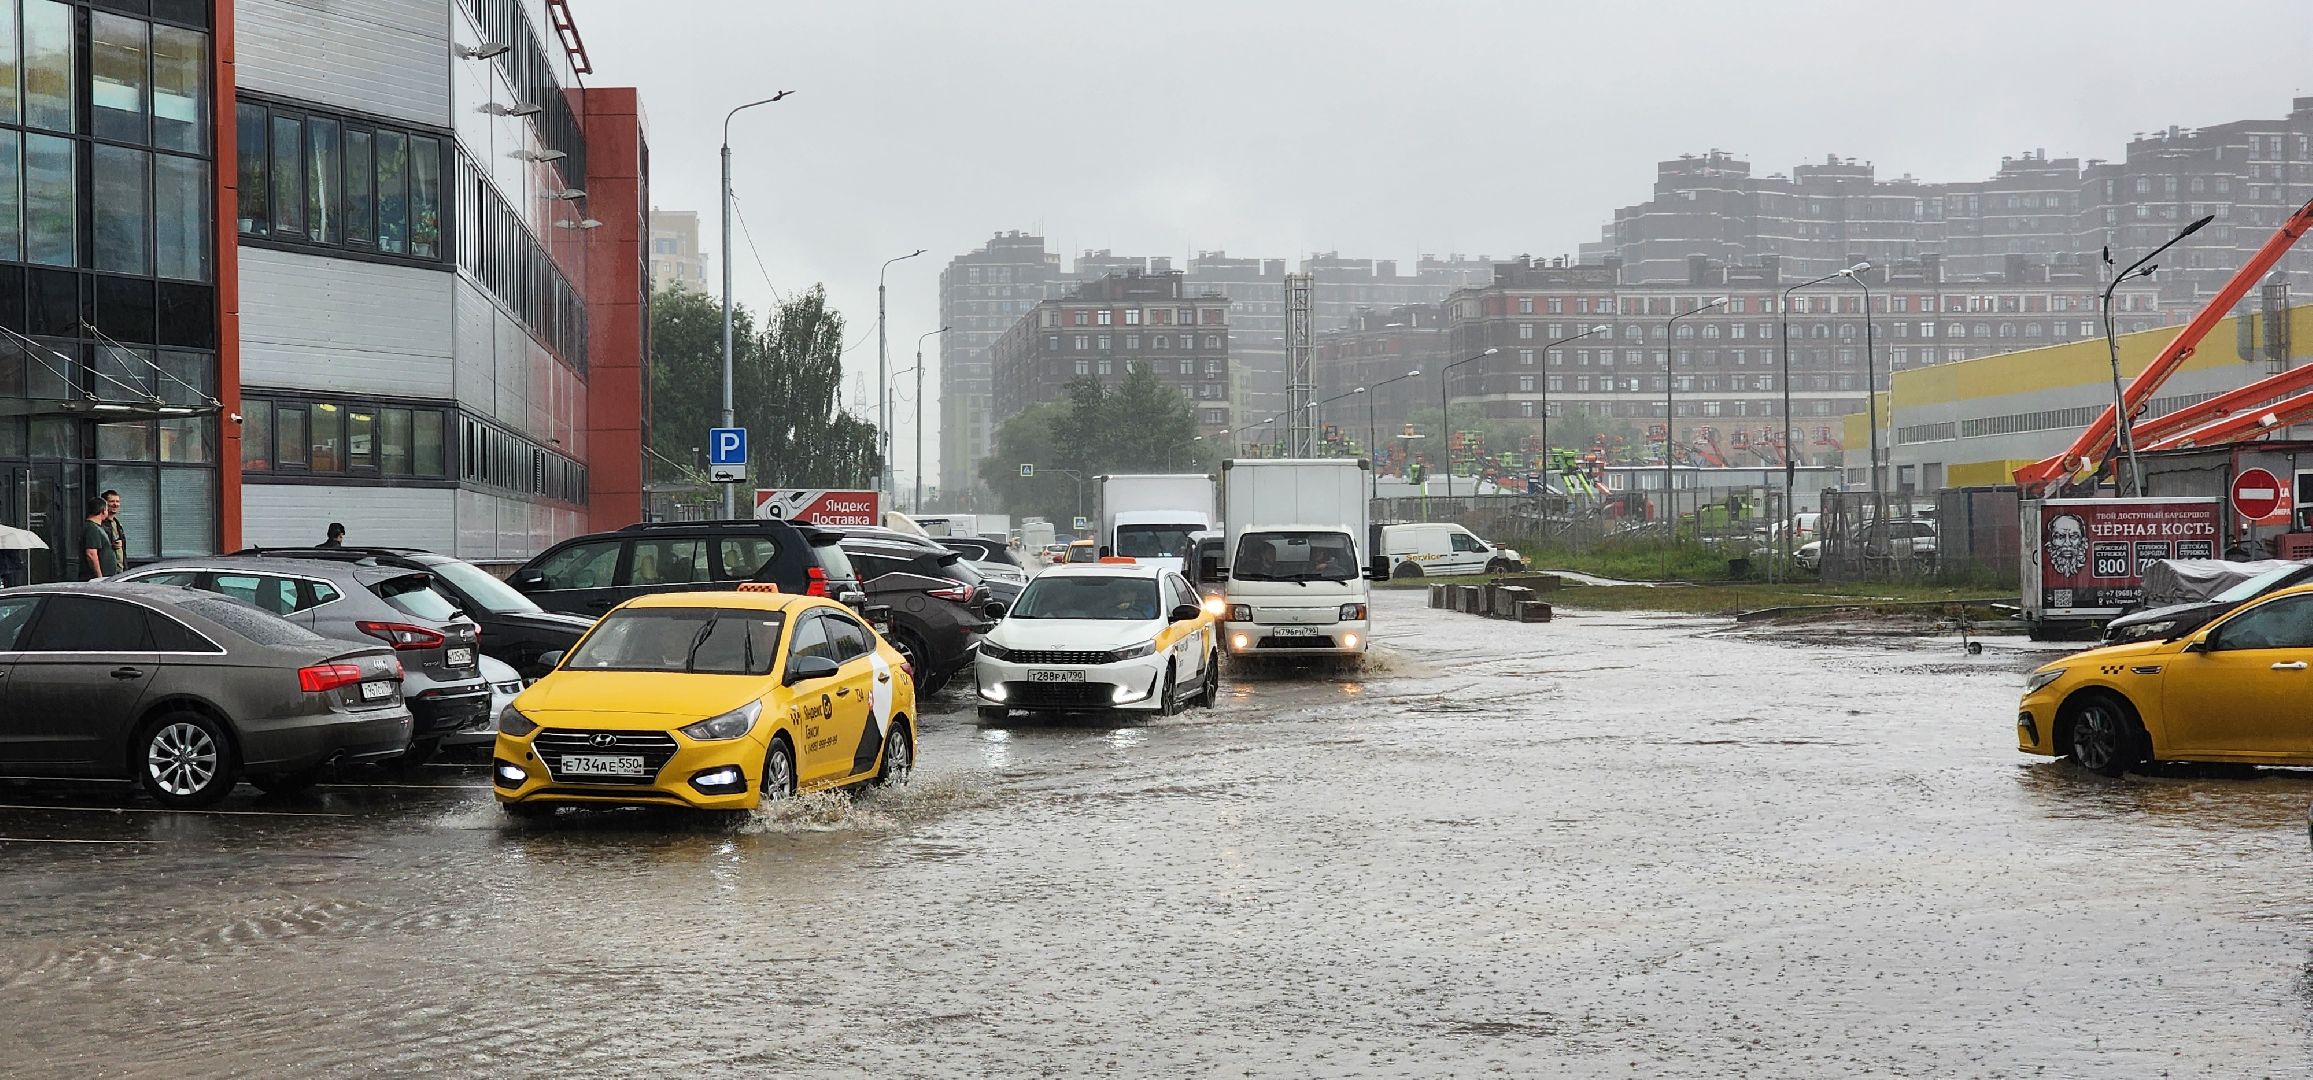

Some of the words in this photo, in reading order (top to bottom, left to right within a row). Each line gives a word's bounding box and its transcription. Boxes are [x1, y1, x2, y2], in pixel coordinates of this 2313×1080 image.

[720, 432, 740, 461] P
[826, 499, 870, 513] Яндекс
[812, 512, 870, 526] Доставка
[2096, 512, 2116, 520] ТВОЙ
[2117, 511, 2164, 520] ДОСТУПНЫЙ
[2165, 511, 2210, 519] БАРБЕРШОП
[2091, 521, 2157, 536] ЧЁРНАЯ
[2161, 522, 2215, 535] КОСТЬ
[2098, 558, 2126, 573] 800
[2105, 589, 2114, 597] +7
[803, 704, 823, 720] Яндекс
[805, 724, 820, 738] Такси
[619, 757, 639, 769] 550
